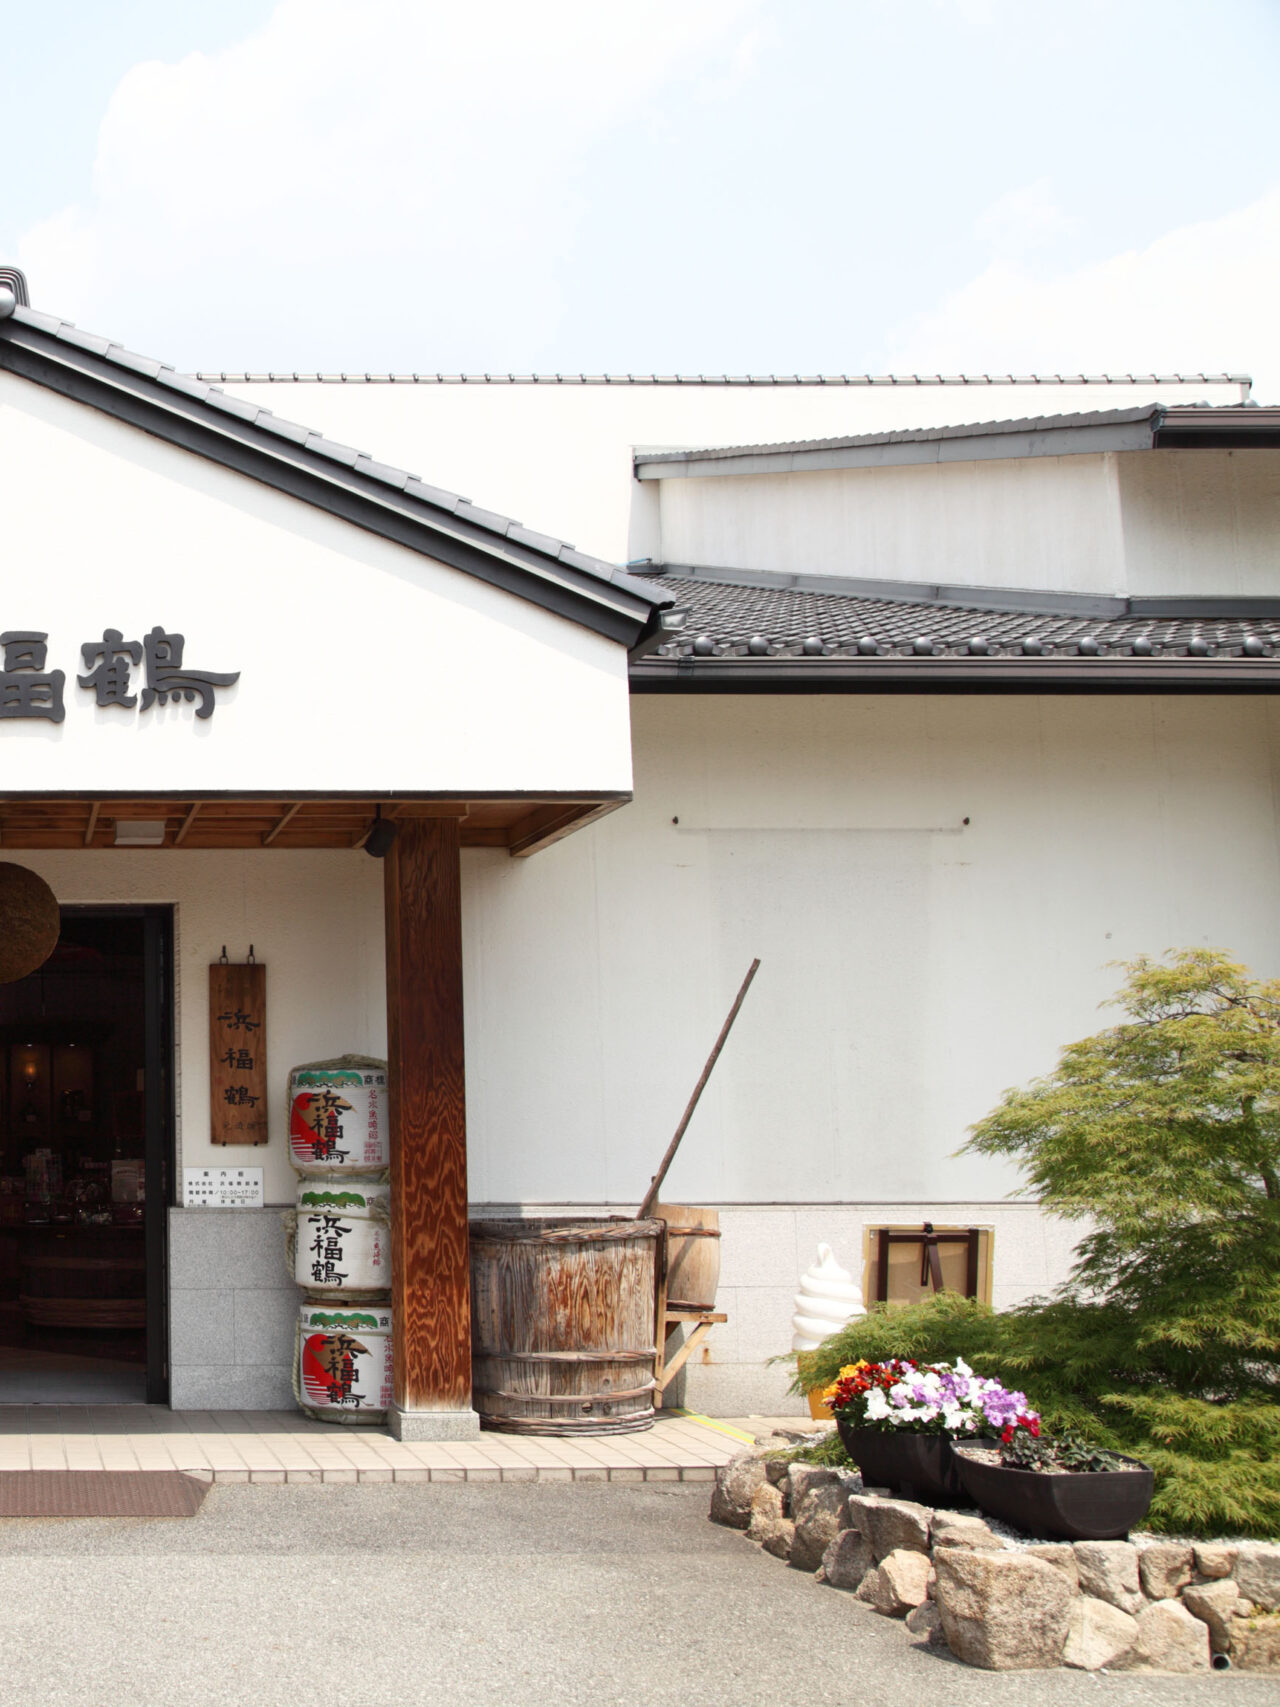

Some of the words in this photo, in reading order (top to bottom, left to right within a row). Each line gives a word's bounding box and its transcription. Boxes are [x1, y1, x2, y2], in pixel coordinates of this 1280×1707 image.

[217, 1008, 260, 1108] 浜福鶴
[307, 1089, 353, 1164] 浜福鶴
[308, 1210, 352, 1287] 浜福鶴
[321, 1334, 369, 1408] 浜福鶴
